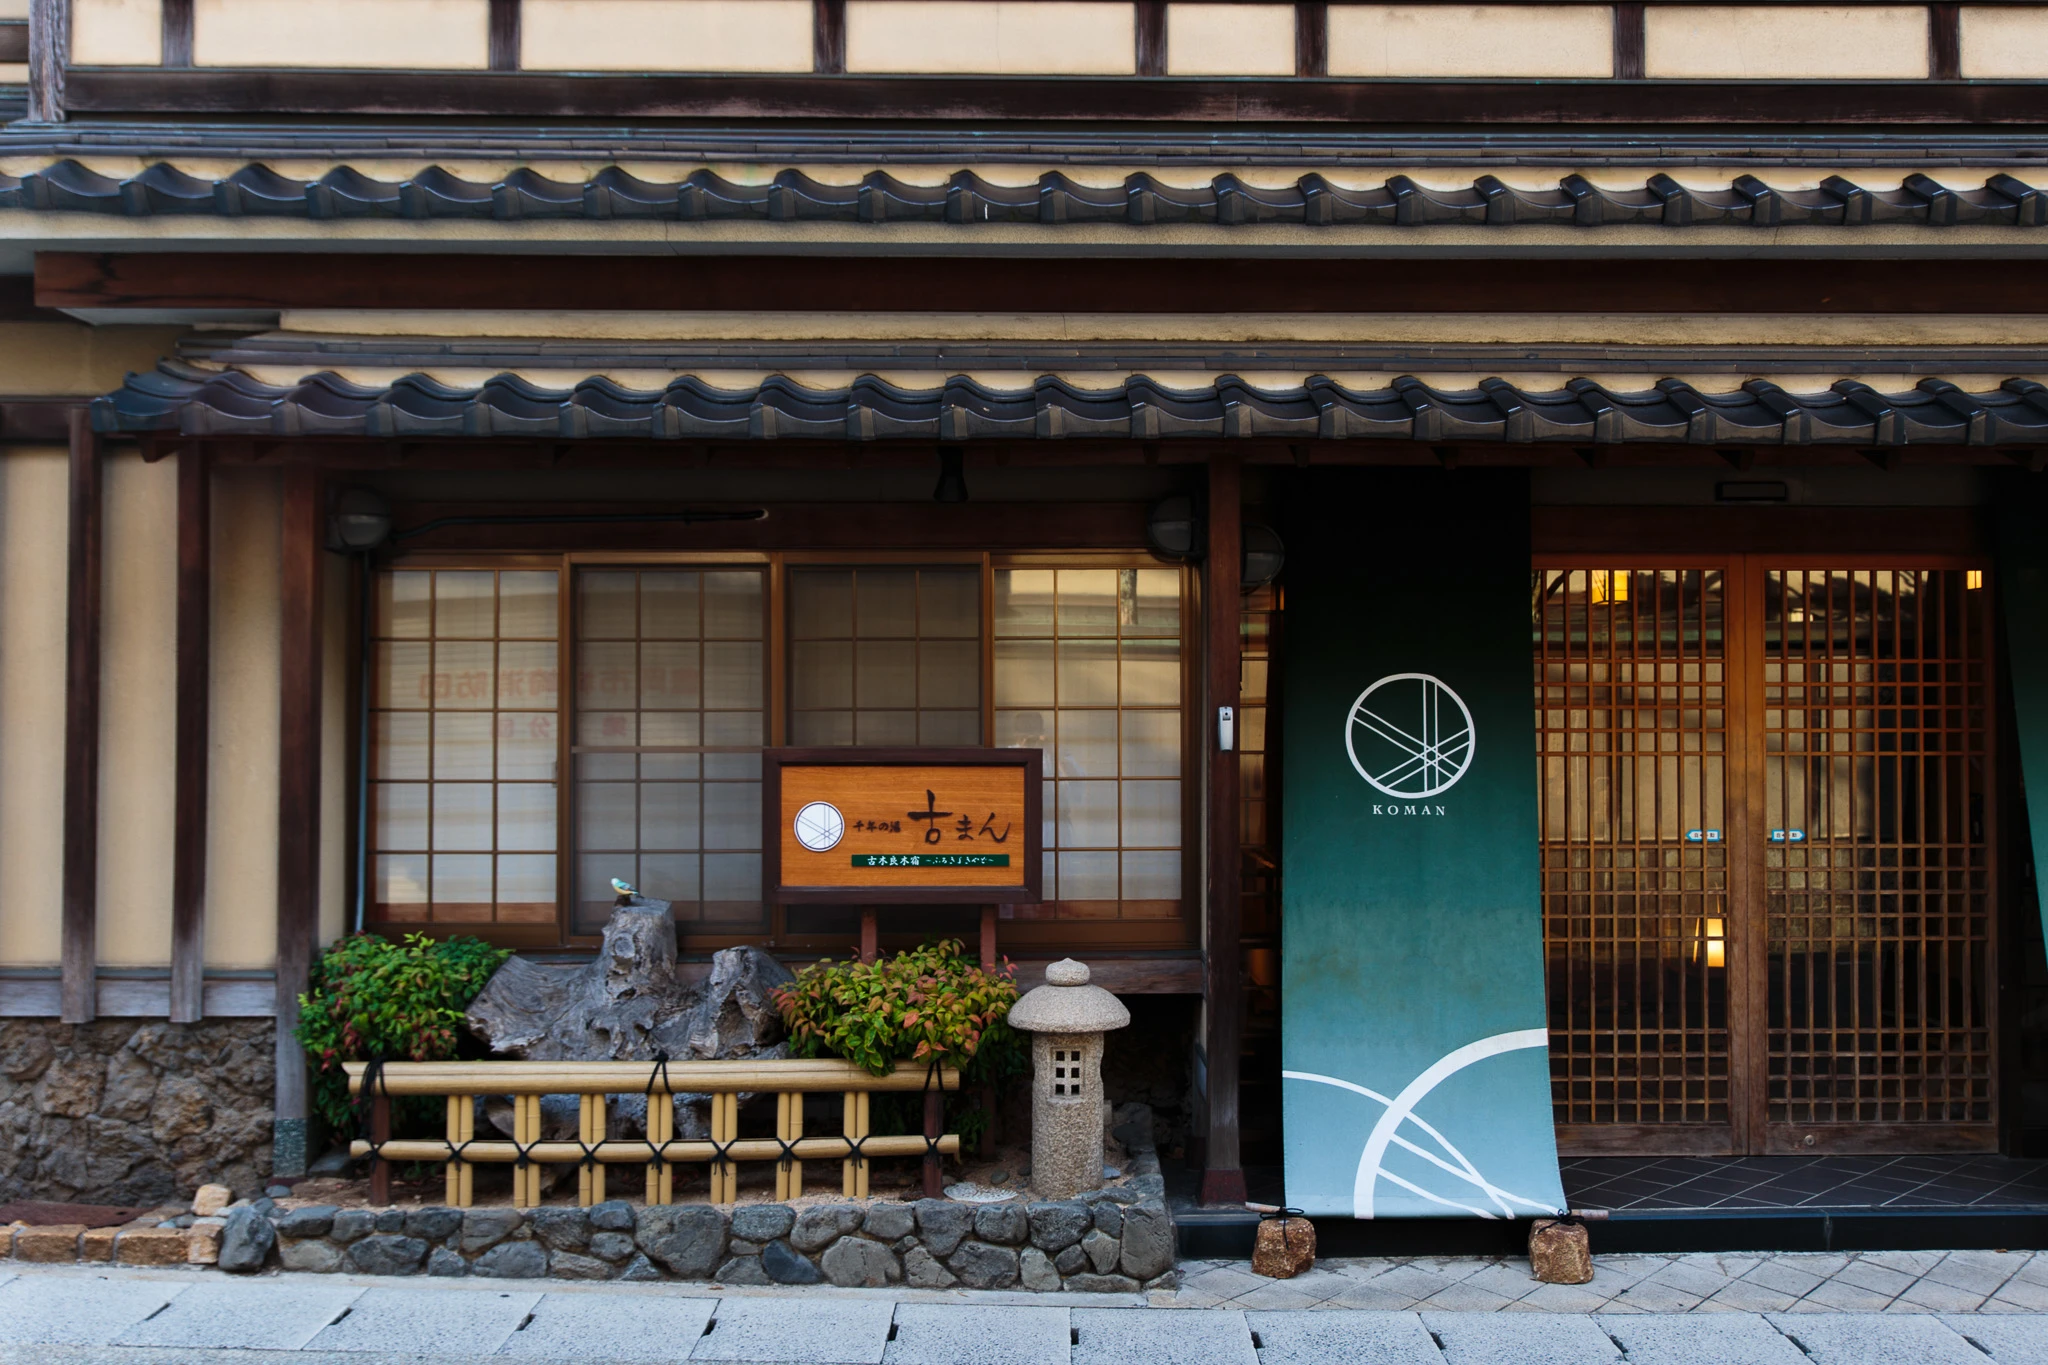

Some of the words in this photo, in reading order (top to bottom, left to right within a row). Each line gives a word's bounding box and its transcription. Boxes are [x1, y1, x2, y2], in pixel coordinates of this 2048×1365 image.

[853, 820, 901, 833] 千年の湯
[907, 789, 1011, 844] 古まん
[1372, 804, 1446, 816] KOMAN
